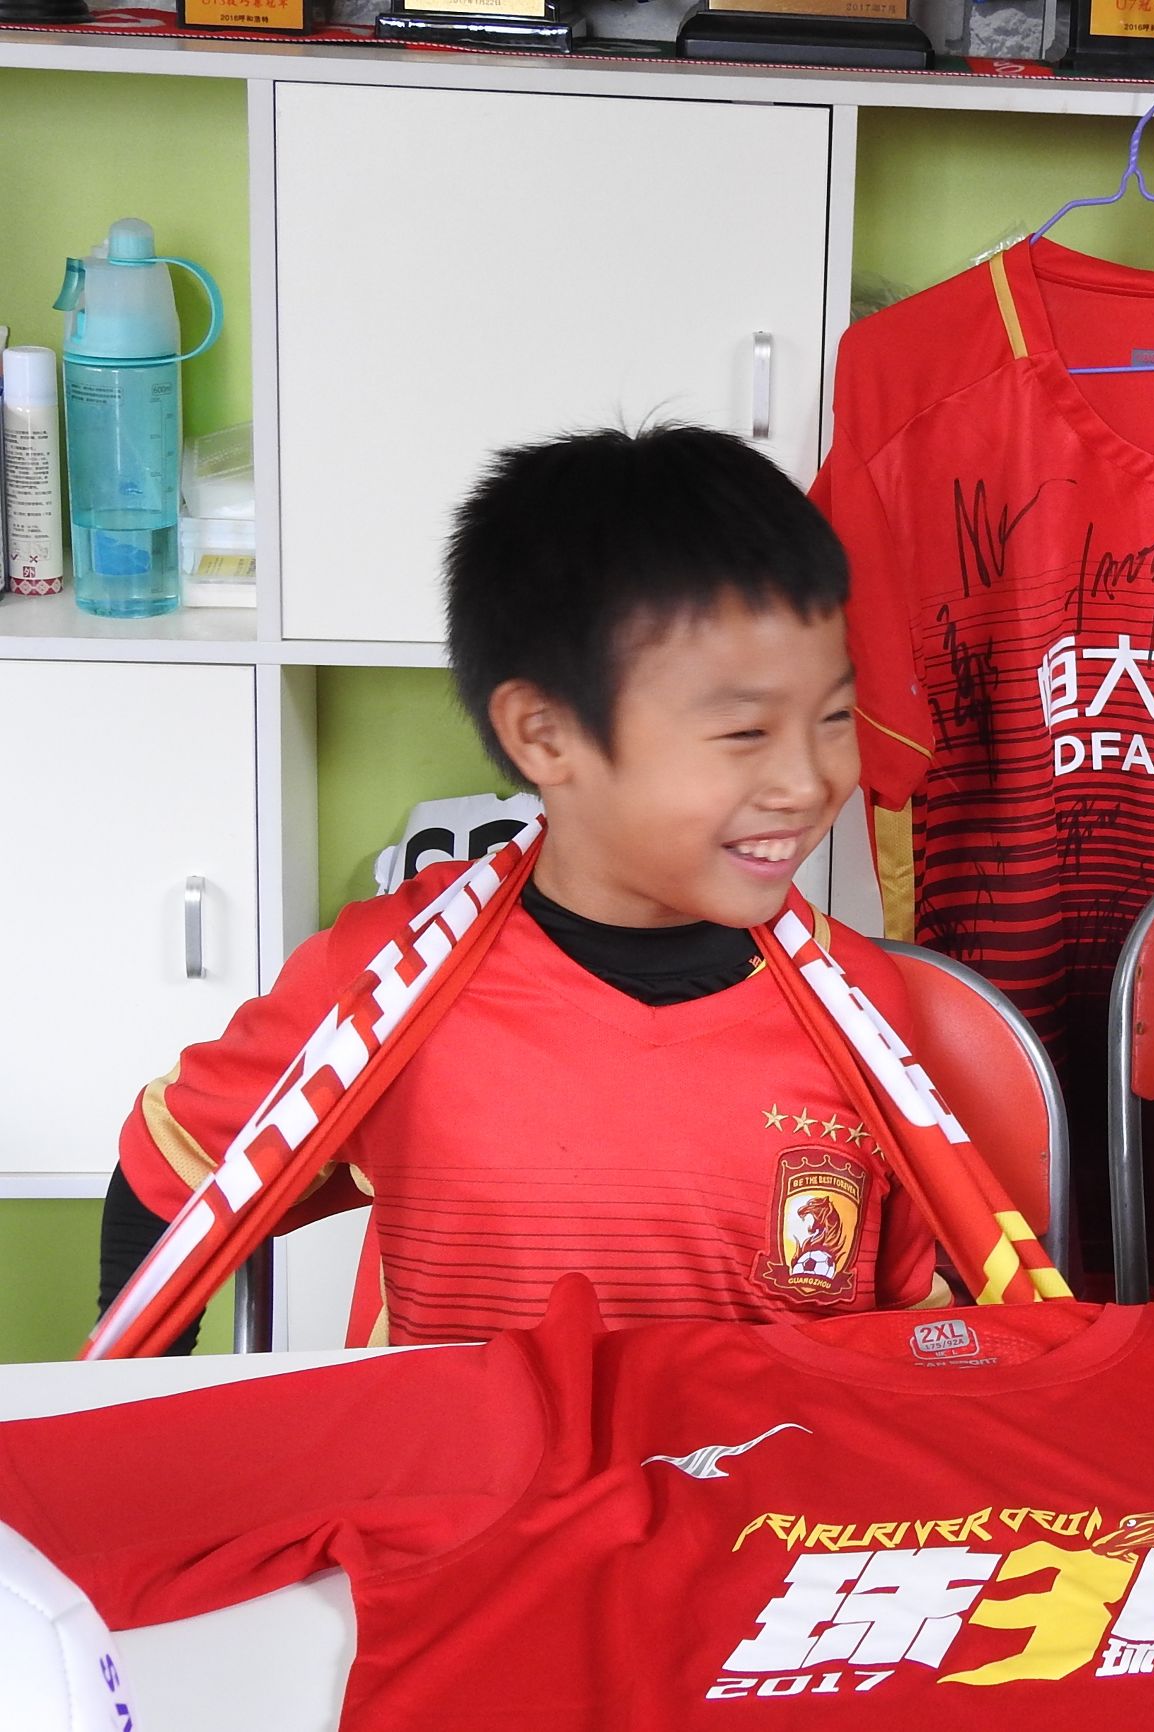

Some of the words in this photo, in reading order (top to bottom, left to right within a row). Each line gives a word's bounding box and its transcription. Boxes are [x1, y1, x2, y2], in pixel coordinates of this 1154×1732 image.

[792, 1177, 804, 1187] BE
[806, 1175, 819, 1184] THE
[818, 1175, 833, 1185] BEST
[833, 1177, 857, 1197] FOREVER
[787, 1277, 832, 1289] GUANGZHOU
[920, 1323, 963, 1343] 2XL
[924, 1338, 964, 1350] 175/92A
[999, 1506, 1102, 1540] DELTA
[705, 1669, 895, 1699] 2017
